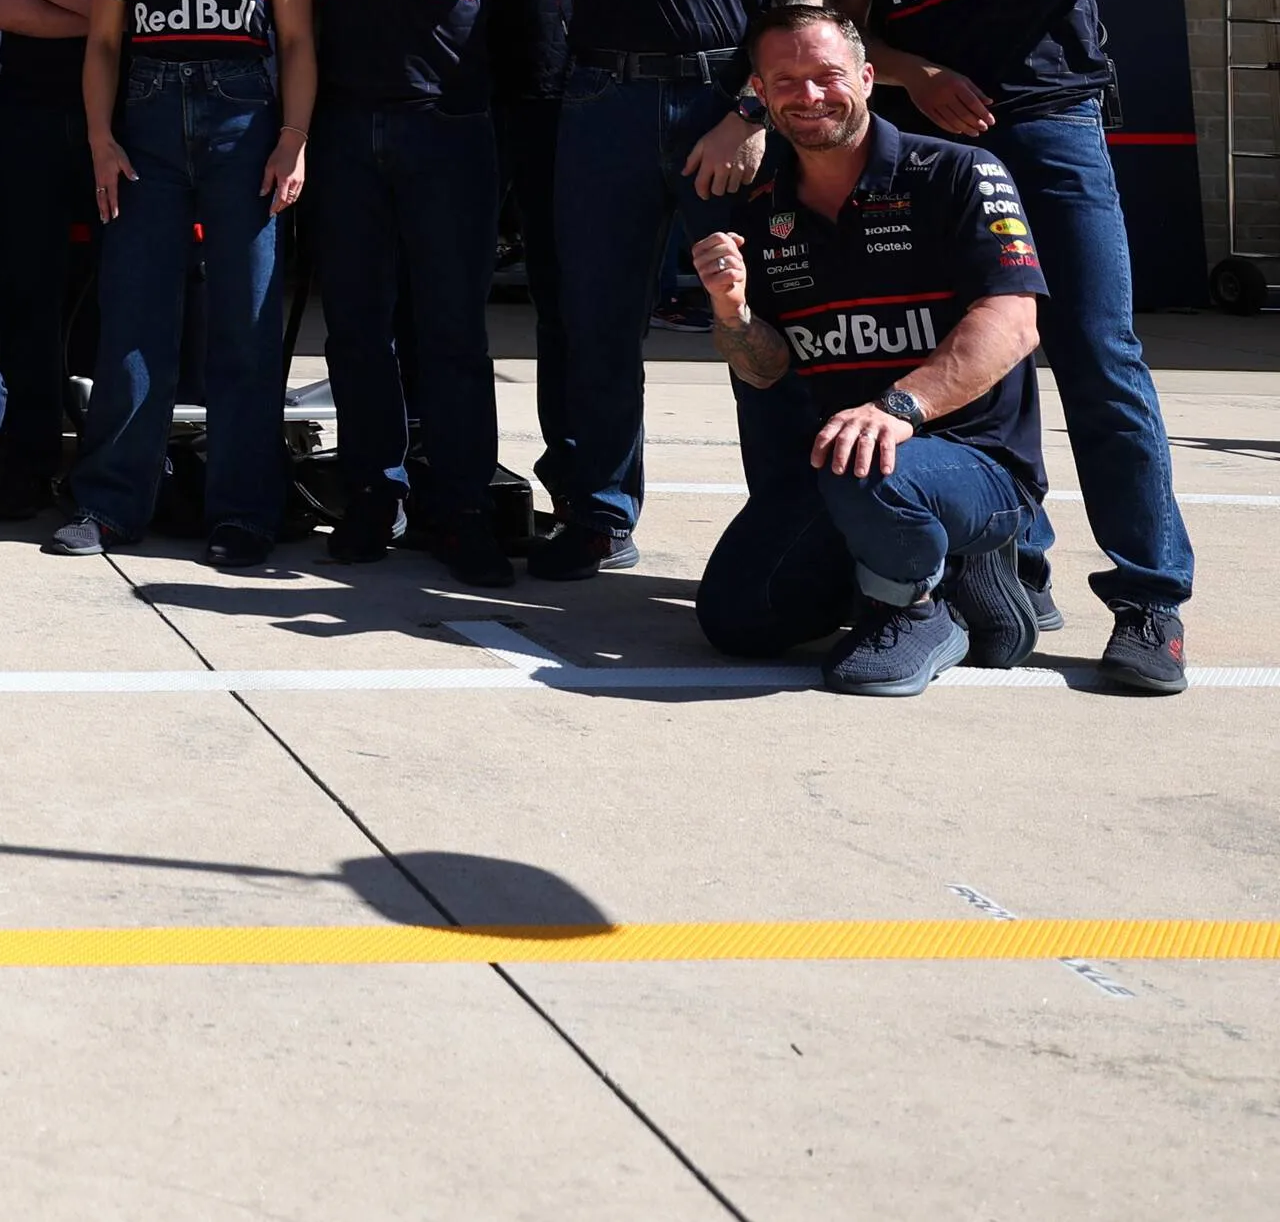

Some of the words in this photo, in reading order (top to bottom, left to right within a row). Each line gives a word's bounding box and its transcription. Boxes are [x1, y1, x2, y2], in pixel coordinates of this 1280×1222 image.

[973, 163, 1007, 178] VISA
[867, 192, 911, 202] ORACLE
[772, 212, 795, 225] TAG
[864, 224, 912, 236] HONDA
[874, 241, 912, 253] Gate.io
[767, 261, 809, 275] ORACLE
[851, 308, 937, 354] Bull
